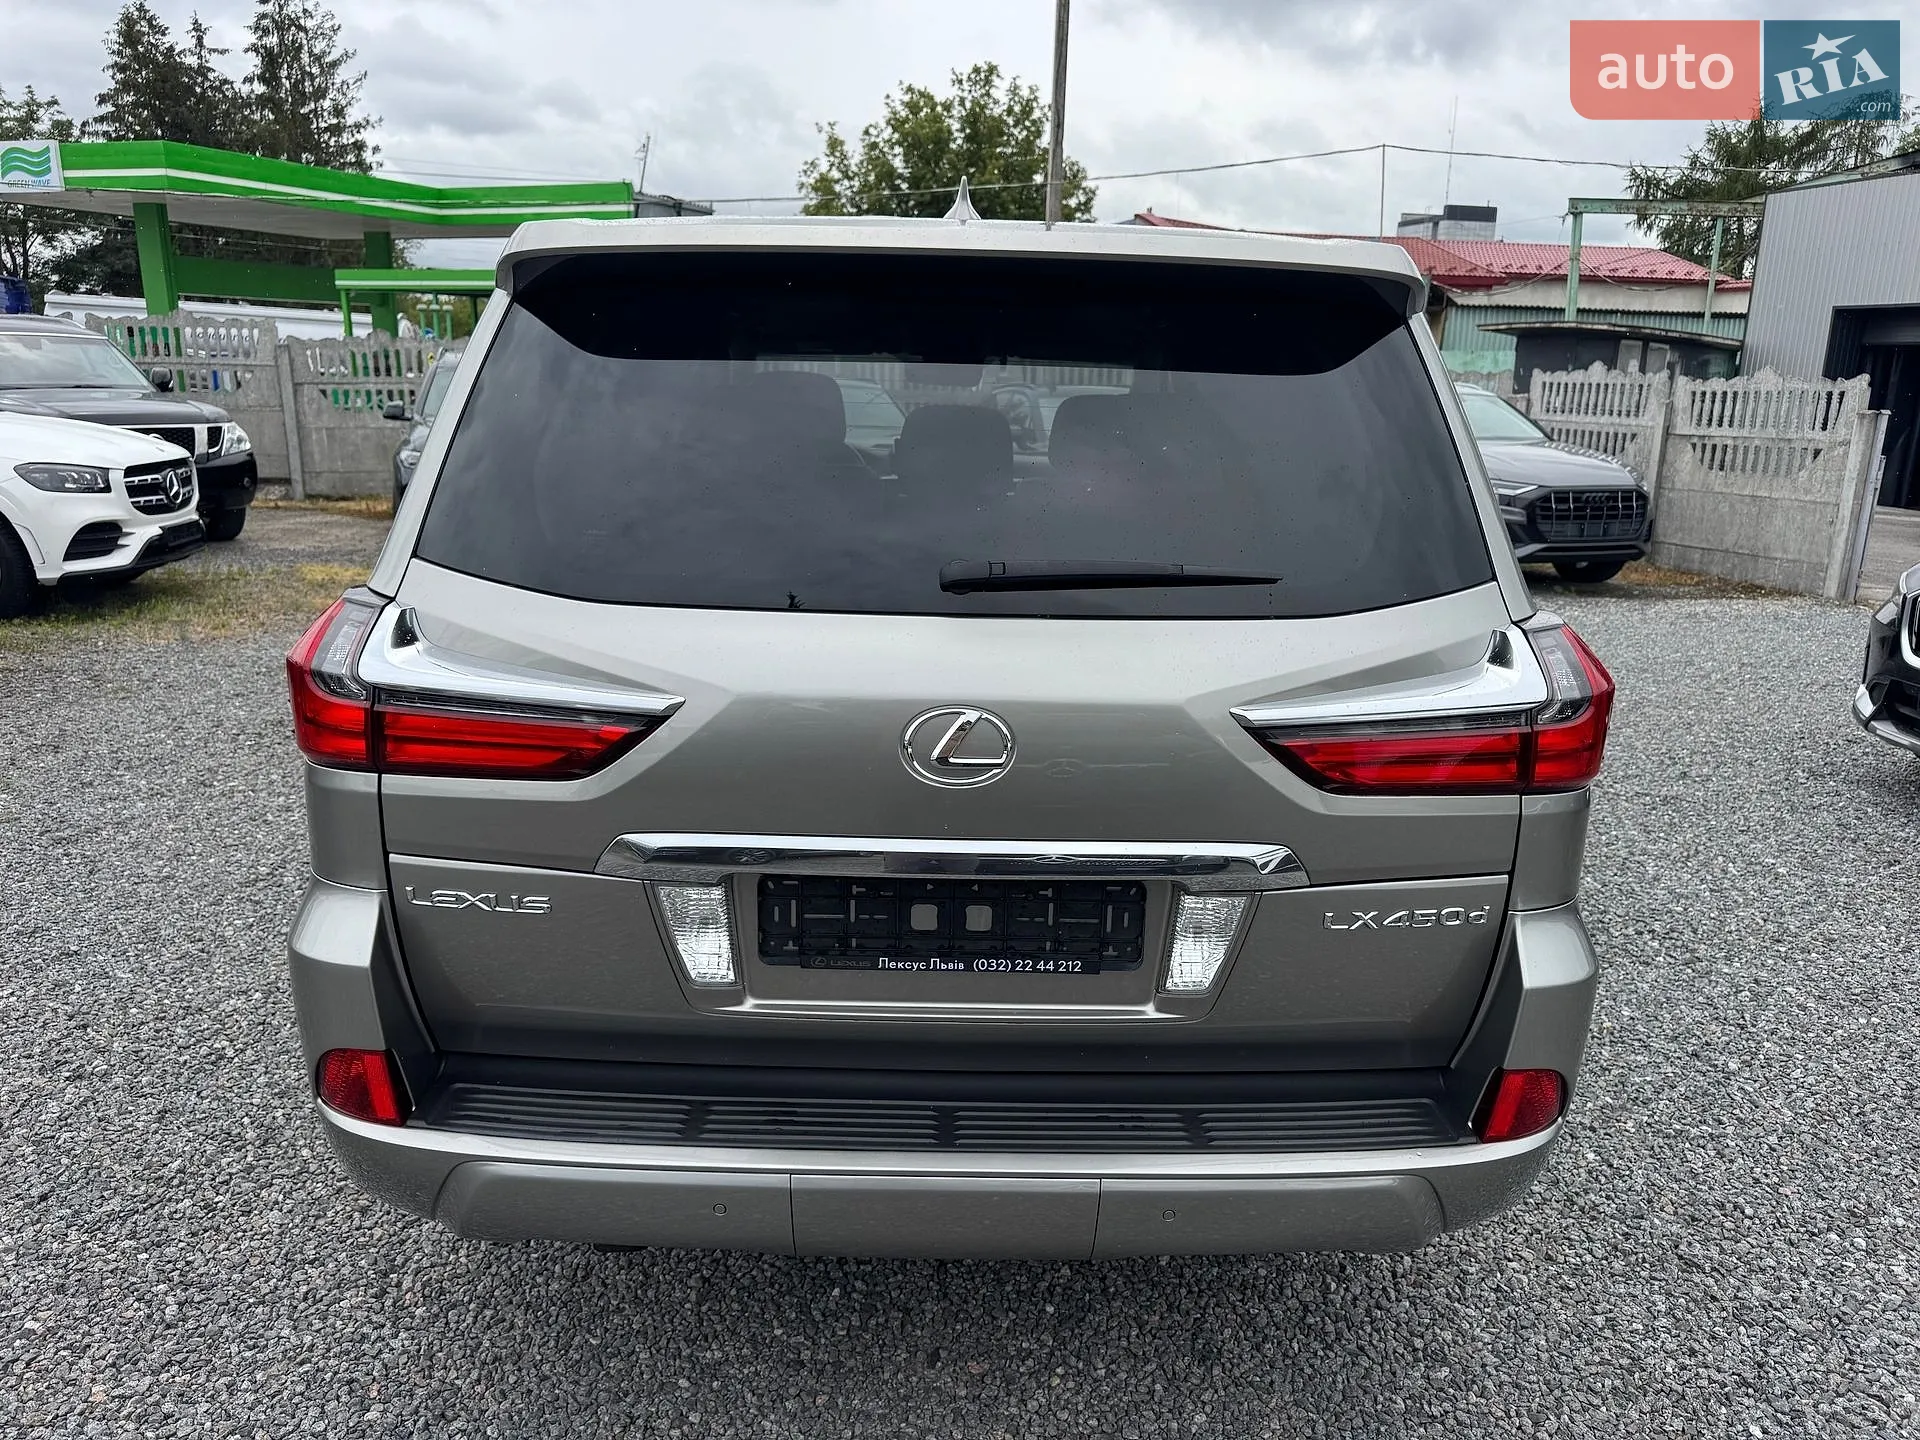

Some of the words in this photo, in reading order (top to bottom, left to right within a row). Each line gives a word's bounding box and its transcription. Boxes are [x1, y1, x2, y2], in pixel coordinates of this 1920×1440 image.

[404, 885, 552, 914] LEXUS
[878, 957, 927, 970] Лексус
[929, 957, 964, 970] Львів
[973, 958, 1012, 973] (032)
[1014, 959, 1033, 971] 22
[1036, 960, 1055, 972] 44
[1058, 960, 1082, 972] 212
